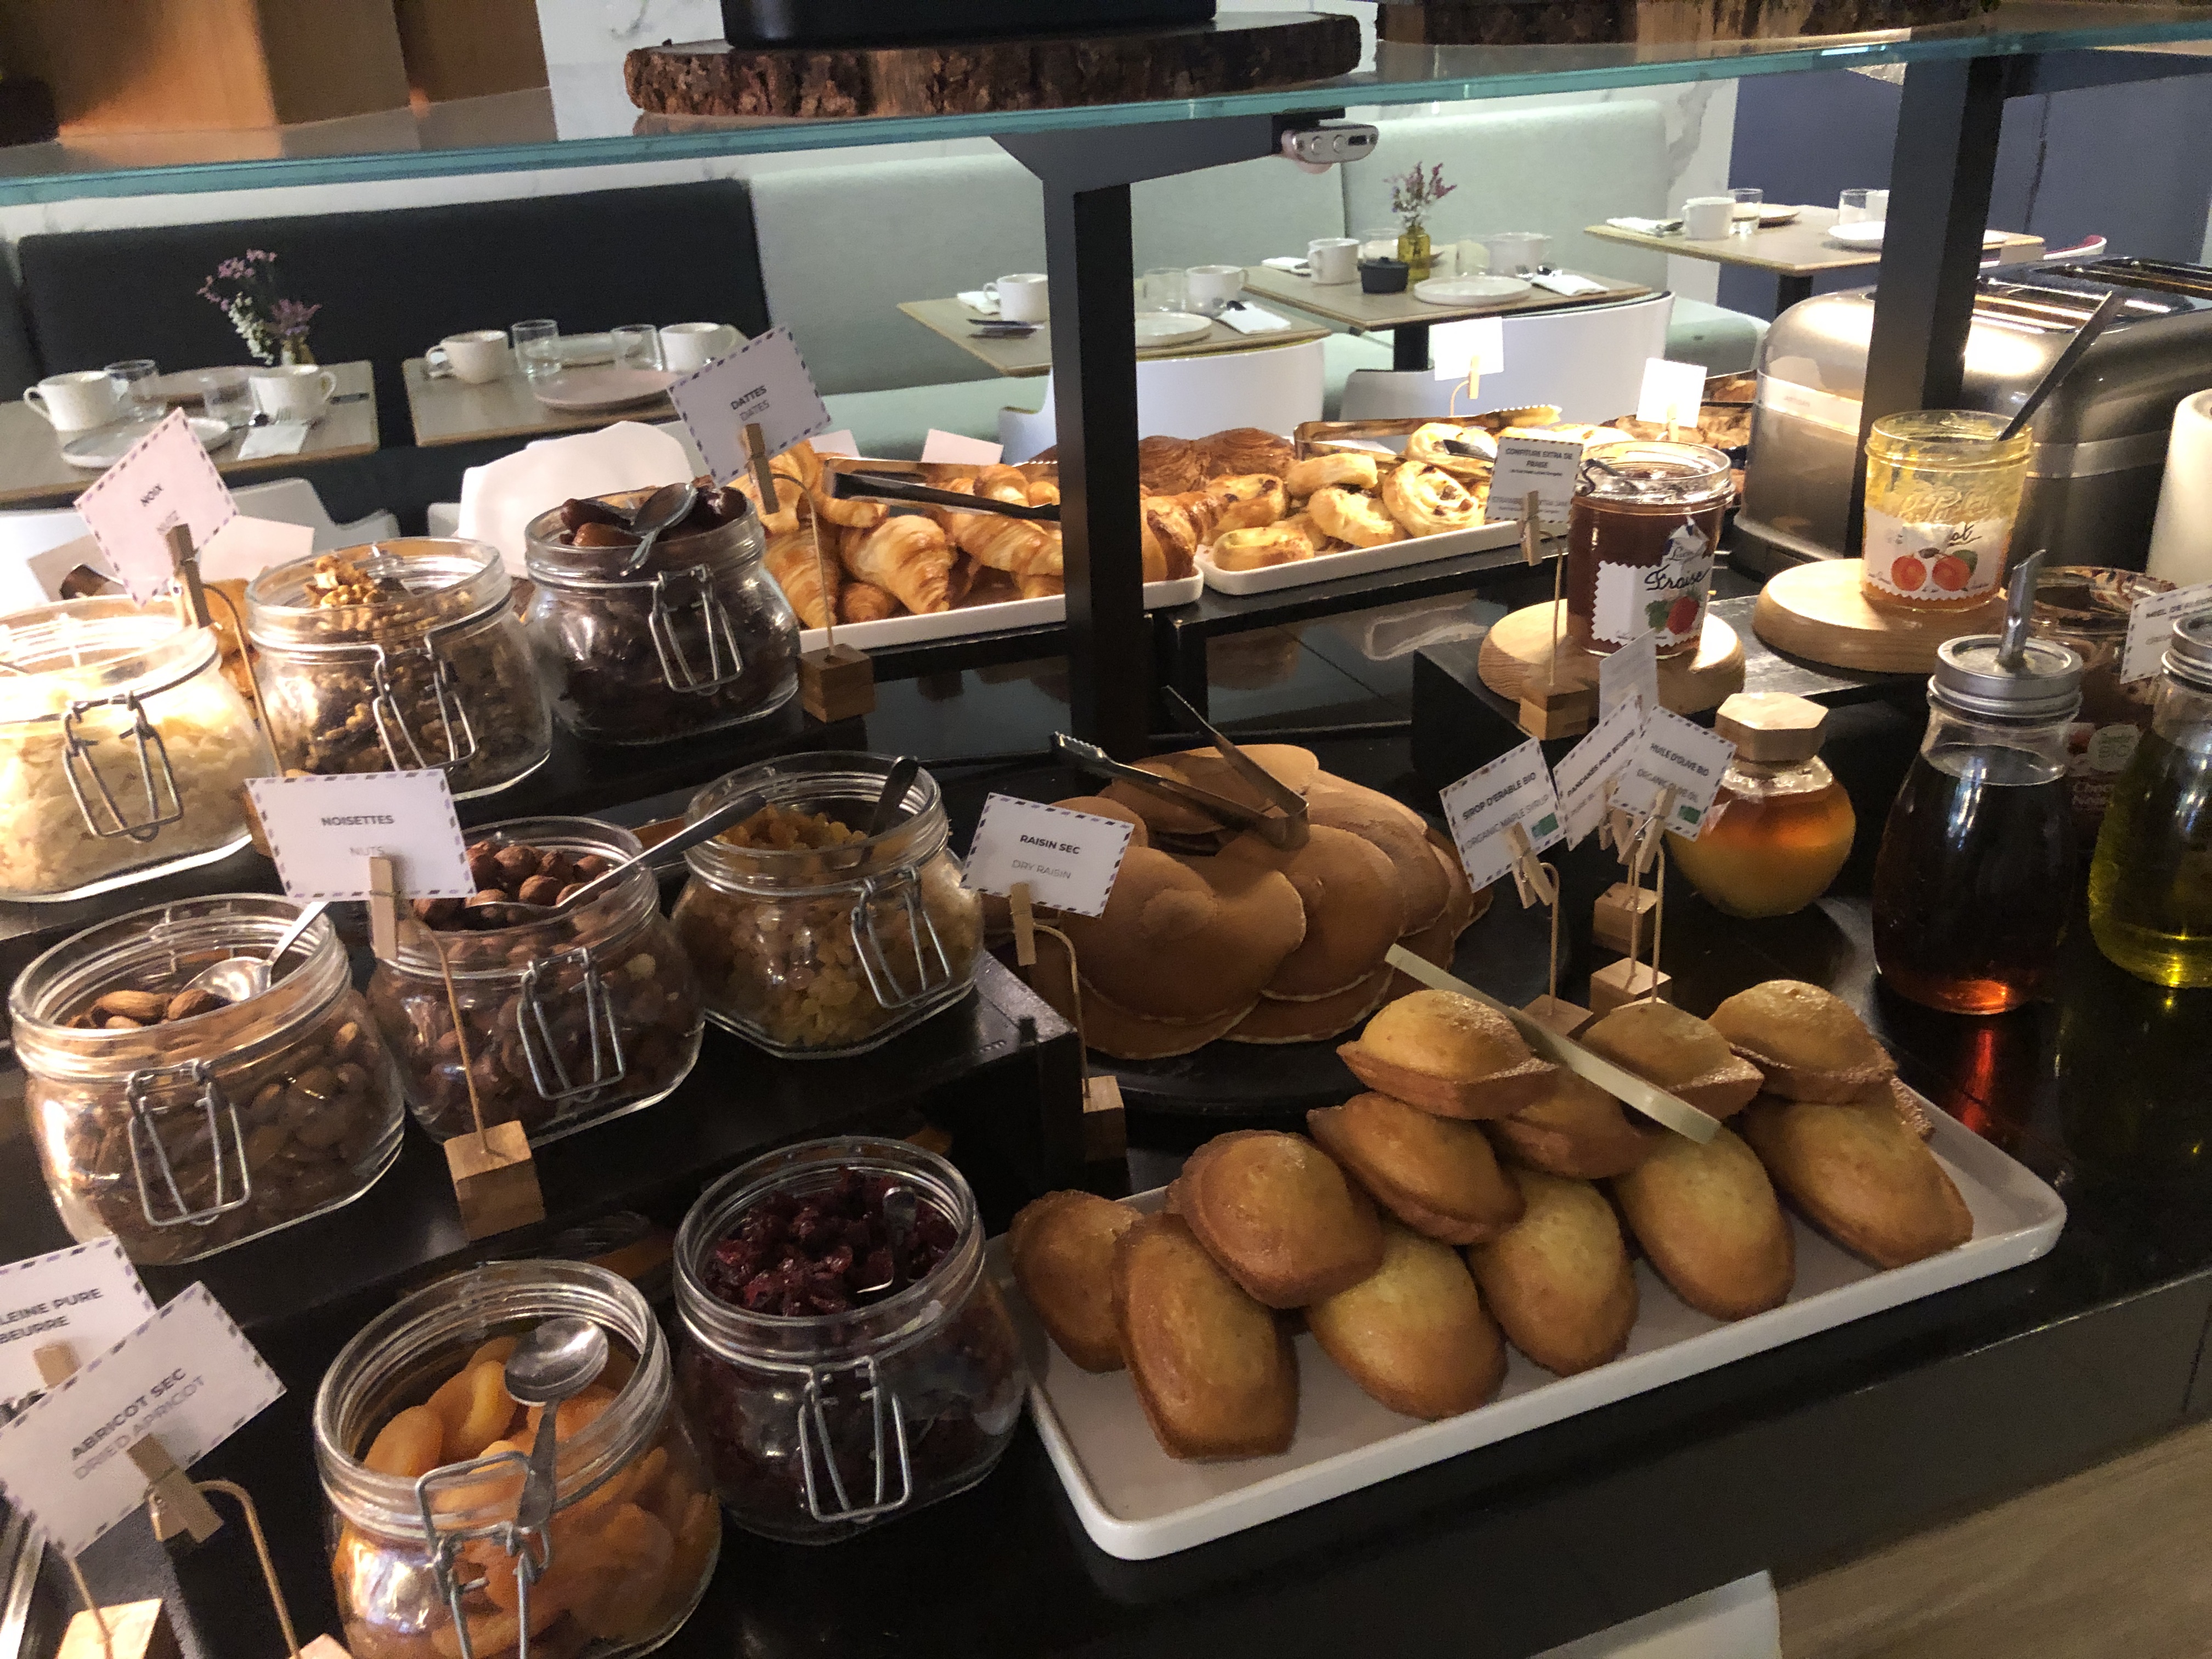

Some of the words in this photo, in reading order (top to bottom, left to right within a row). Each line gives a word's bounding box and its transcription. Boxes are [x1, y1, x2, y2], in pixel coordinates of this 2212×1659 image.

[731, 385, 767, 410] DATTES
[740, 400, 770, 421] DATES
[140, 484, 163, 507] NOIX
[1644, 564, 1712, 591] Fraise
[1463, 802, 1486, 820] SIROP
[1523, 772, 1536, 785] BIO
[321, 815, 394, 826] NOISETTES
[1020, 834, 1057, 849] RAISIN
[1059, 843, 1080, 854] SEC
[1012, 859, 1035, 871] DRY
[1036, 865, 1071, 879] RAISIN
[53, 1288, 104, 1310] PURE
[72, 1395, 148, 1460] ABRICOT
[150, 1368, 186, 1398] SEC
[73, 1435, 132, 1480] DRIED
[133, 1375, 204, 1437] APRICOT
